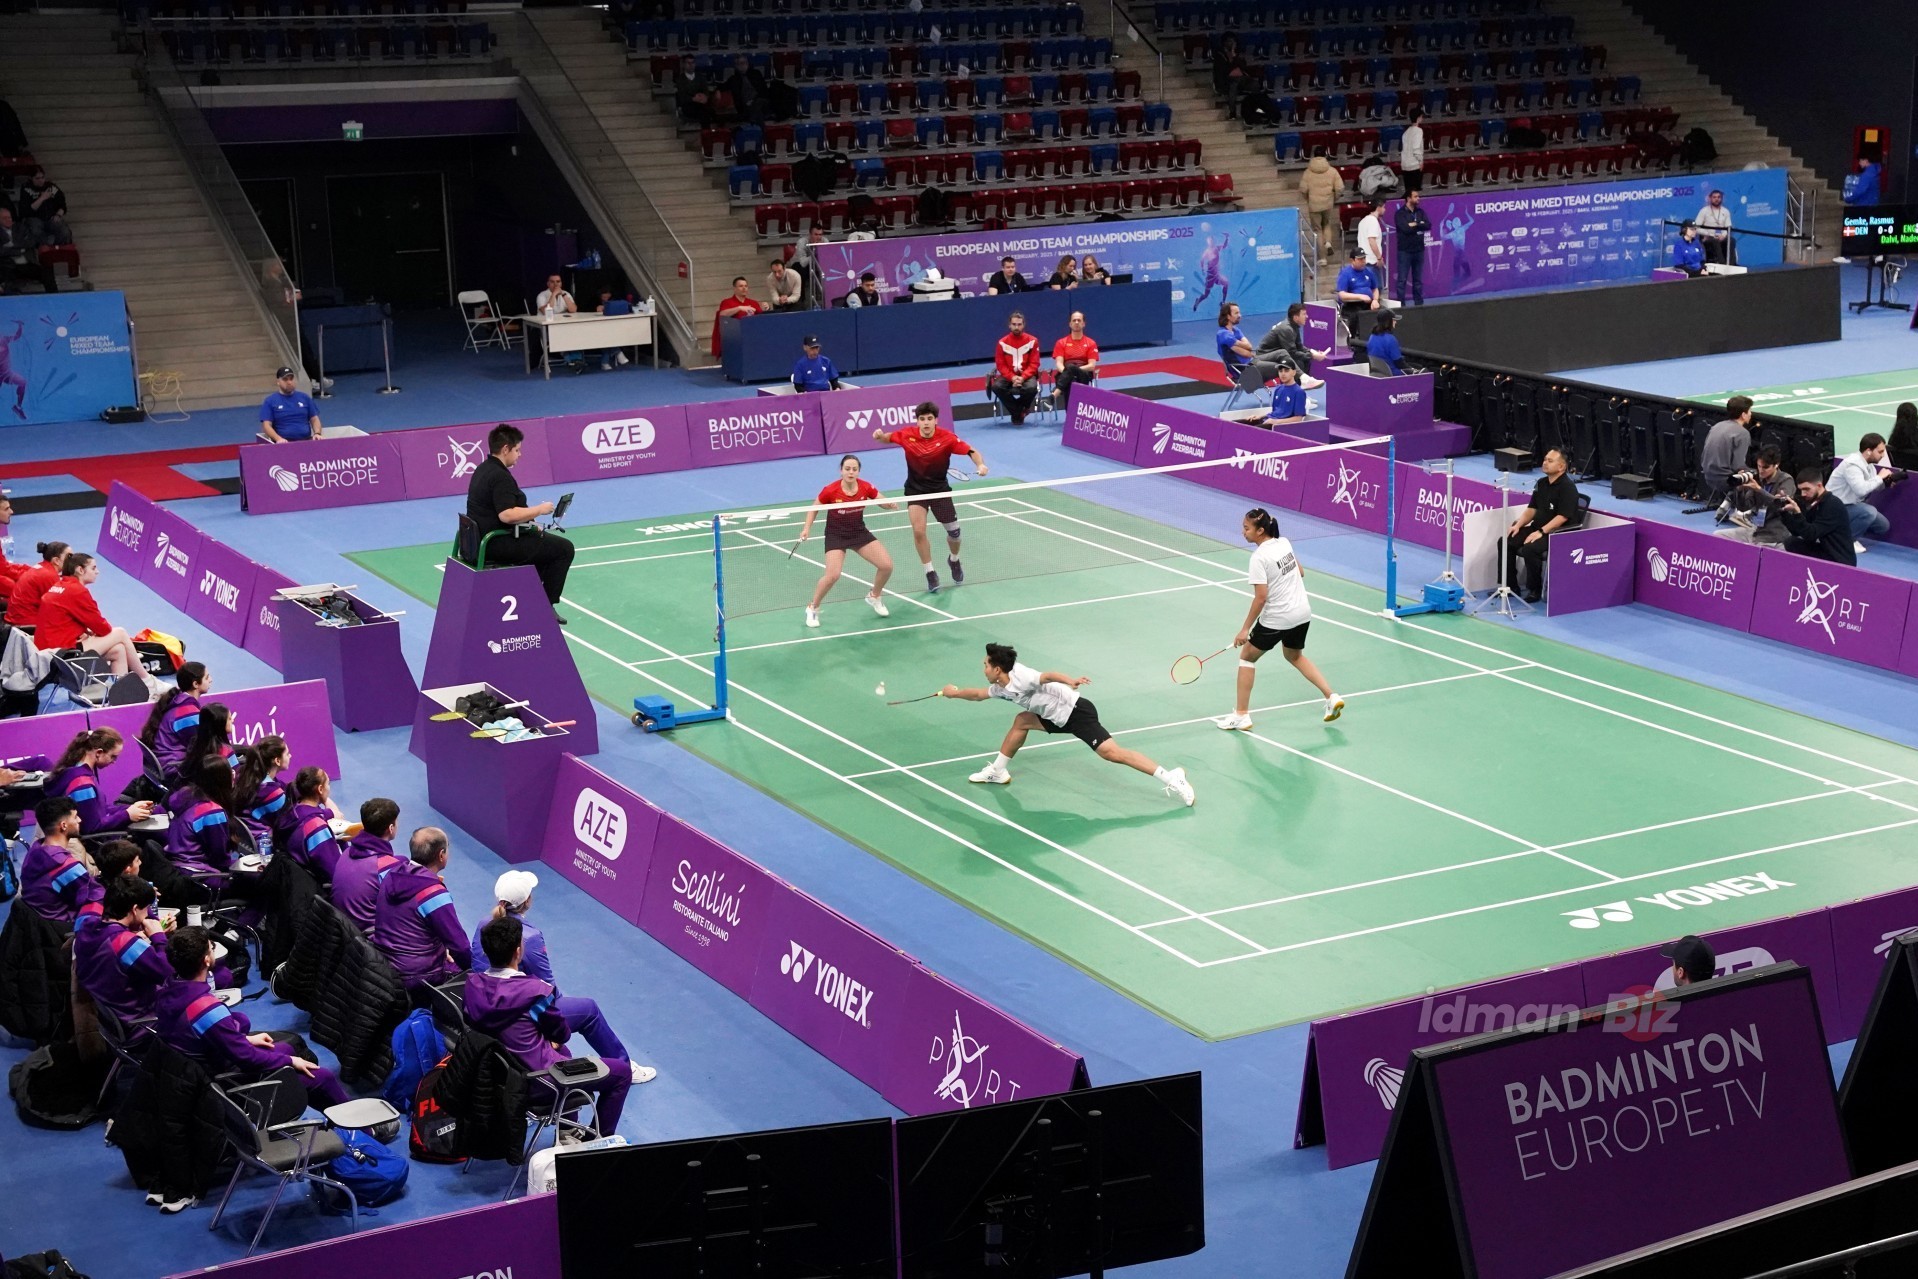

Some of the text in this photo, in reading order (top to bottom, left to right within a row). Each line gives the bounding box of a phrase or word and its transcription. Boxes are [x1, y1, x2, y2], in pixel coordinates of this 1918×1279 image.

[1475, 186, 1694, 214] EUROPEAN MIXED TEAM CHAMPIONSHIPS 2025
[1592, 222, 1608, 231] YONEX
[1844, 216, 1894, 226] Gemke, Rasmus
[1855, 226, 1868, 235] DEN
[936, 227, 1194, 258] EUROPEAN MIXED TEAM CHAMPIONSHIPS 2025
[1568, 240, 1584, 248] YONEX
[1881, 234, 1900, 244] Dalvi,
[1548, 258, 1564, 266] YONEX
[71, 346, 130, 355] CHAMPIONSHIPS
[708, 410, 804, 433] BADMINTON
[876, 405, 918, 426] YONE
[1077, 402, 1129, 429] BADMINTON
[596, 424, 642, 448] AZE
[710, 426, 804, 450] EUROPE.TV
[1074, 417, 1126, 444] EUROPE.COM
[1173, 432, 1206, 448] BADMINTON
[598, 455, 626, 464] MINISTRY
[1171, 442, 1205, 458] AZERBAIJAN
[300, 456, 378, 474] BADMINTON
[612, 460, 632, 468] SPORT
[1252, 454, 1289, 481] YONEX
[301, 468, 379, 491] EUROPE
[119, 510, 144, 533] BADMINTON
[115, 524, 141, 552] EUROPE
[1671, 552, 1736, 580] BADMINTON
[1668, 566, 1734, 600] EUROPE
[214, 577, 240, 613] YONEX
[500, 595, 519, 622] 2
[1846, 622, 1862, 632] BAKU
[502, 634, 541, 645] BADMINTON
[502, 640, 541, 653] EUROPE
[580, 801, 618, 849] AZE
[573, 858, 597, 878] AND SPORT
[576, 848, 616, 880] MINISTRY OF YOUTH
[1634, 872, 1797, 911] YONEX
[673, 900, 729, 942] RISTORANTE ITALIANO
[814, 958, 874, 1027] YONEX
[1504, 1023, 1763, 1125] BADMINTON
[1514, 1071, 1766, 1181] EUROPE.TV
